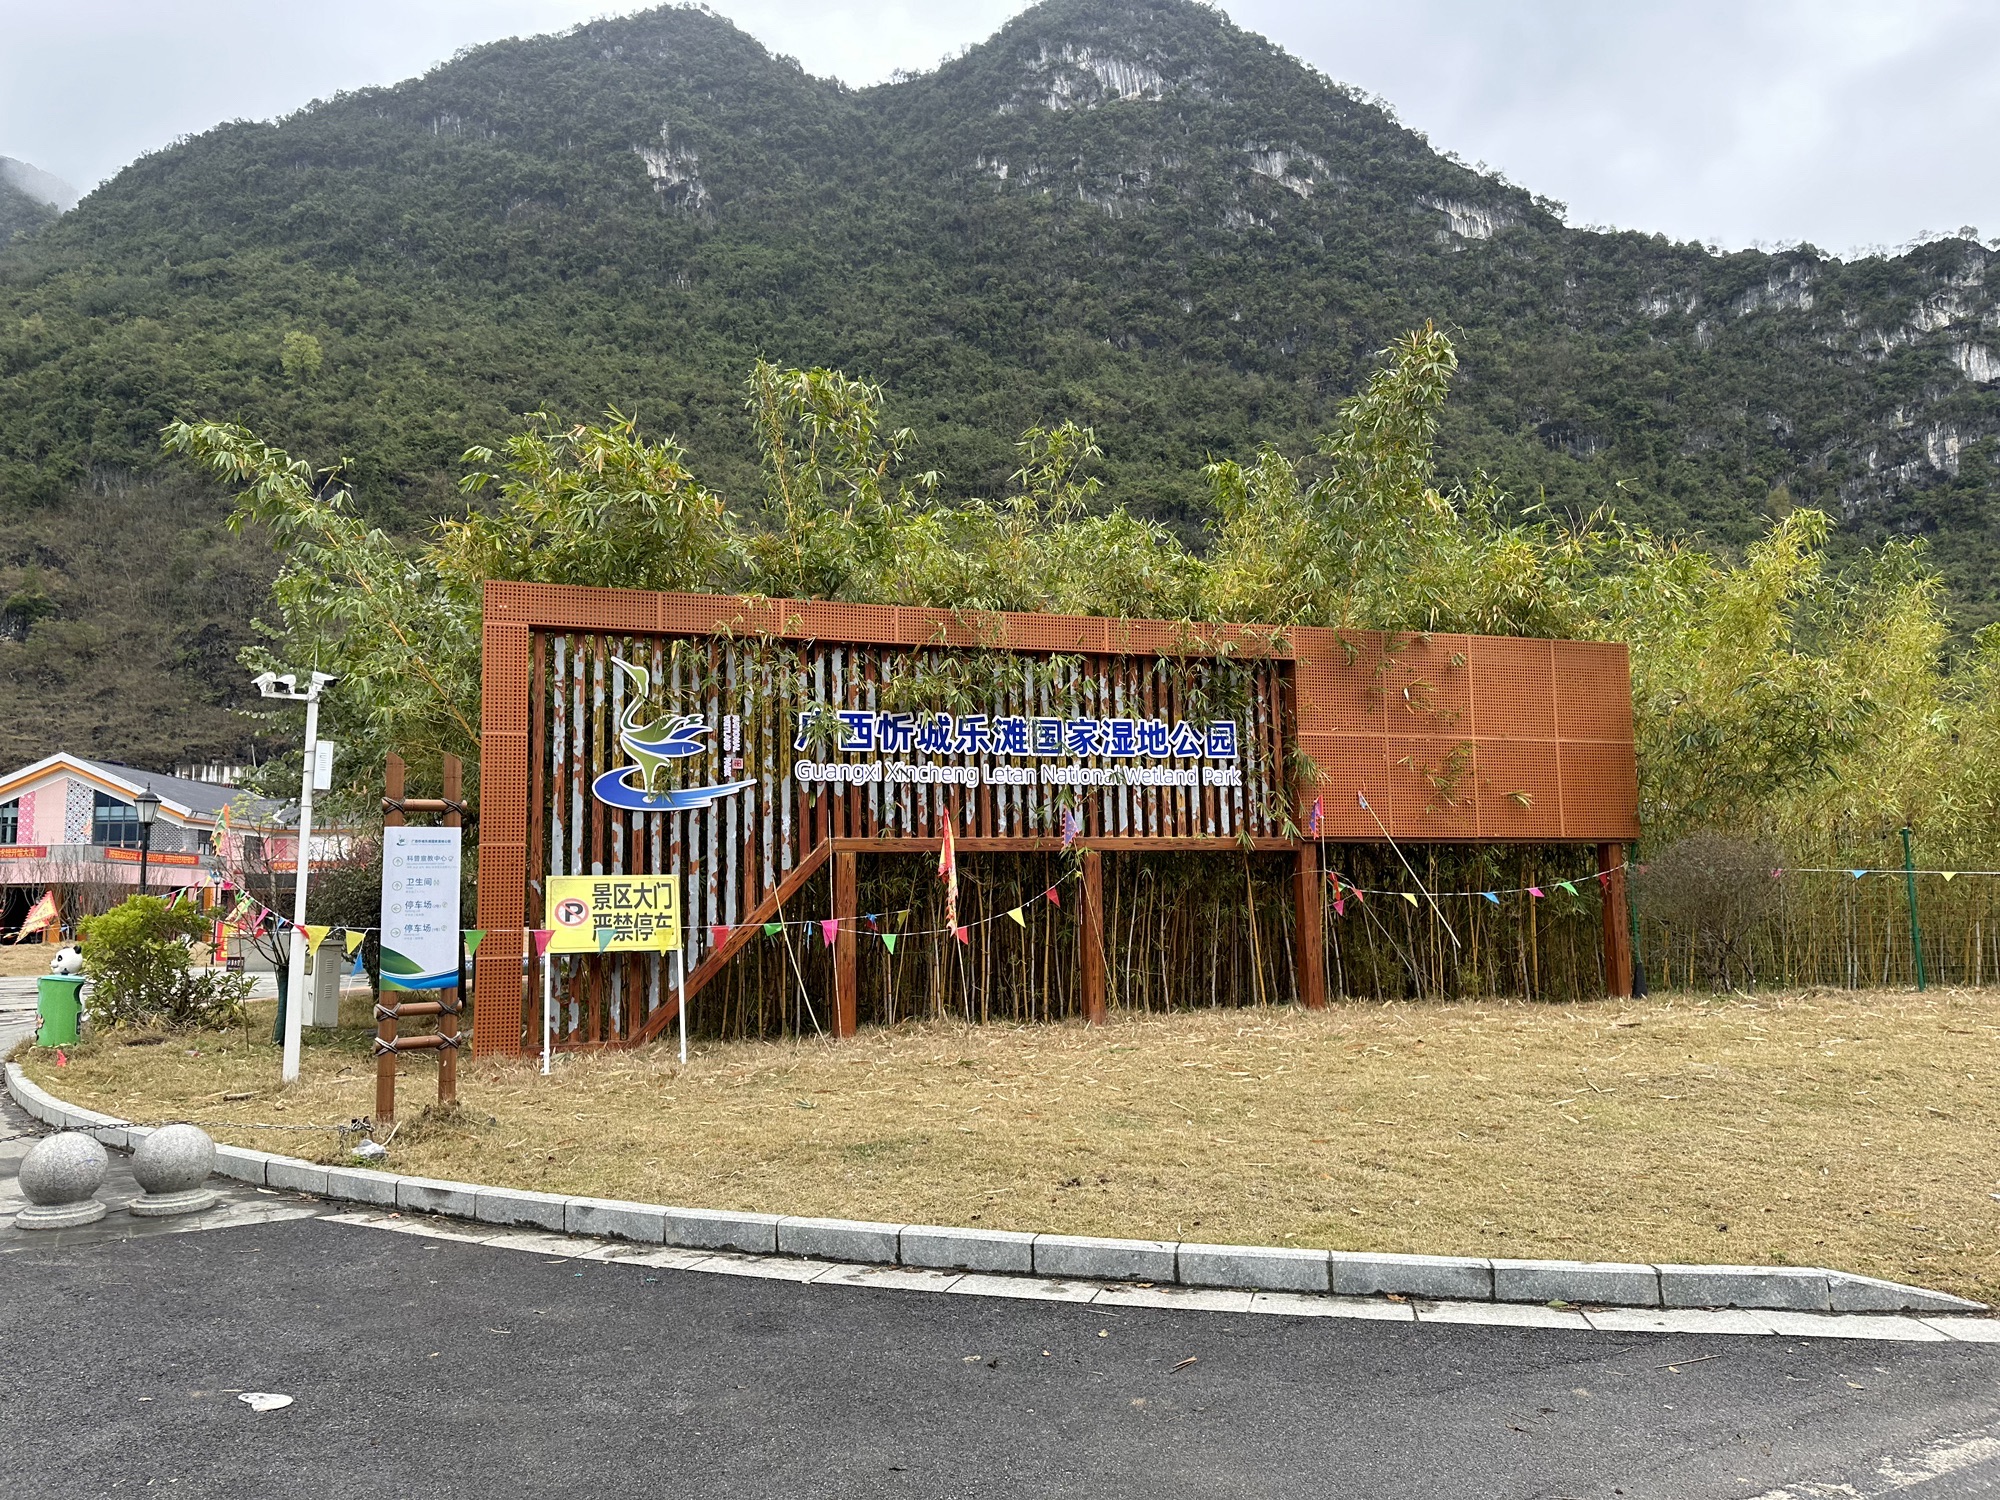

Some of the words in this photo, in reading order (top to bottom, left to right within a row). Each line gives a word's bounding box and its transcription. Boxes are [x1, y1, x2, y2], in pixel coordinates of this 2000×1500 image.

[795, 761, 882, 785] Guangxi
[885, 762, 979, 788] Xincheng
[985, 764, 1036, 785] Letan
[1041, 765, 1121, 786] National
[1124, 766, 1199, 786] Wetland
[1203, 767, 1242, 787] Park
[405, 878, 433, 887] 卫生间
[405, 900, 432, 909] 停车场
[592, 882, 672, 910] 景区大门
[403, 924, 432, 933] 停车场
[592, 912, 674, 942] 严禁停车
